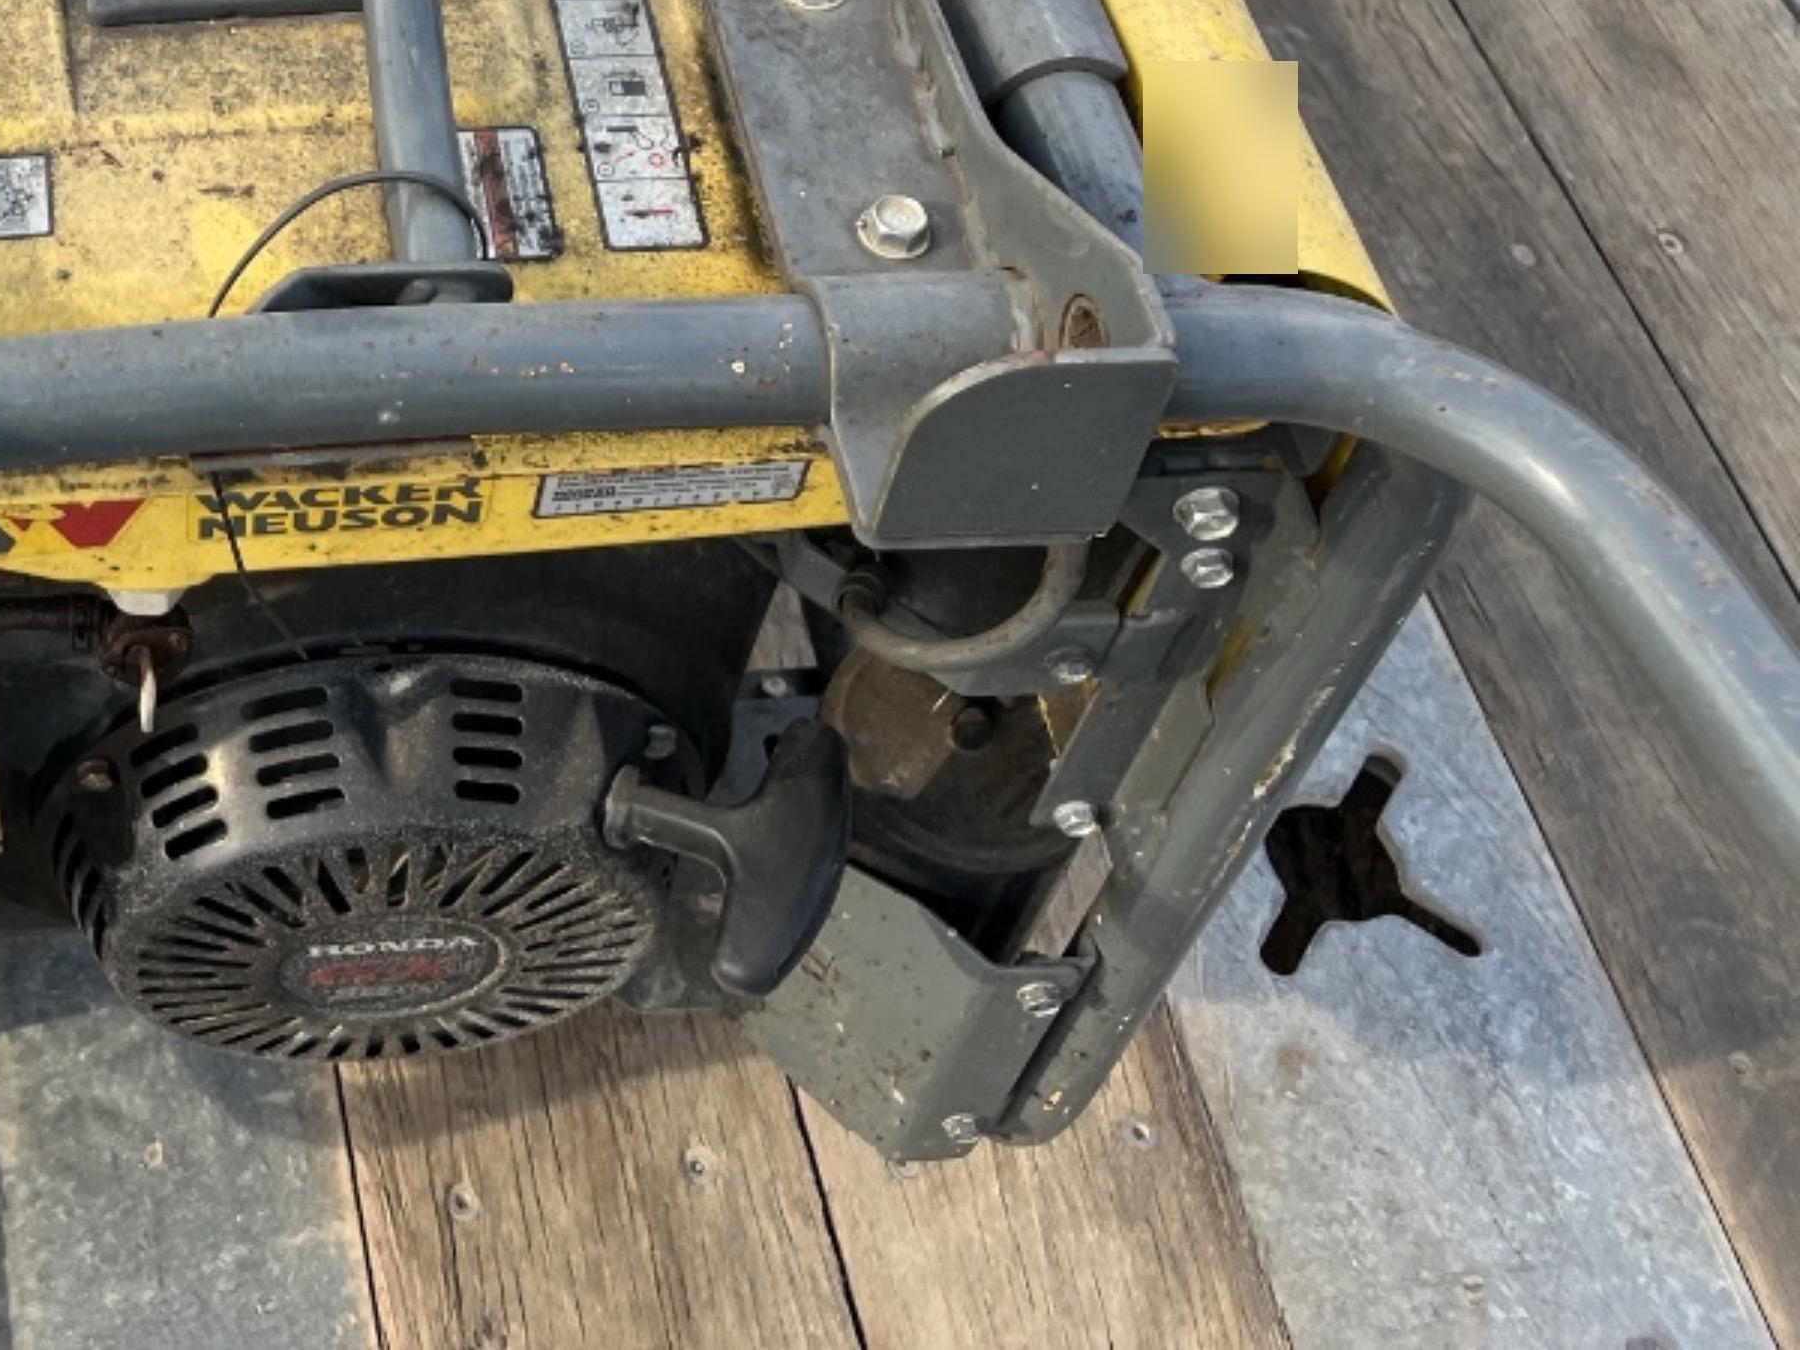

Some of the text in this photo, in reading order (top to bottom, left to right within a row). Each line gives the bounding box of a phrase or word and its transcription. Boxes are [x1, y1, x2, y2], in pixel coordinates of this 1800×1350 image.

[195, 478, 484, 513] WACKER
[197, 501, 483, 540] NEUSON
[307, 936, 479, 958] HONDA
